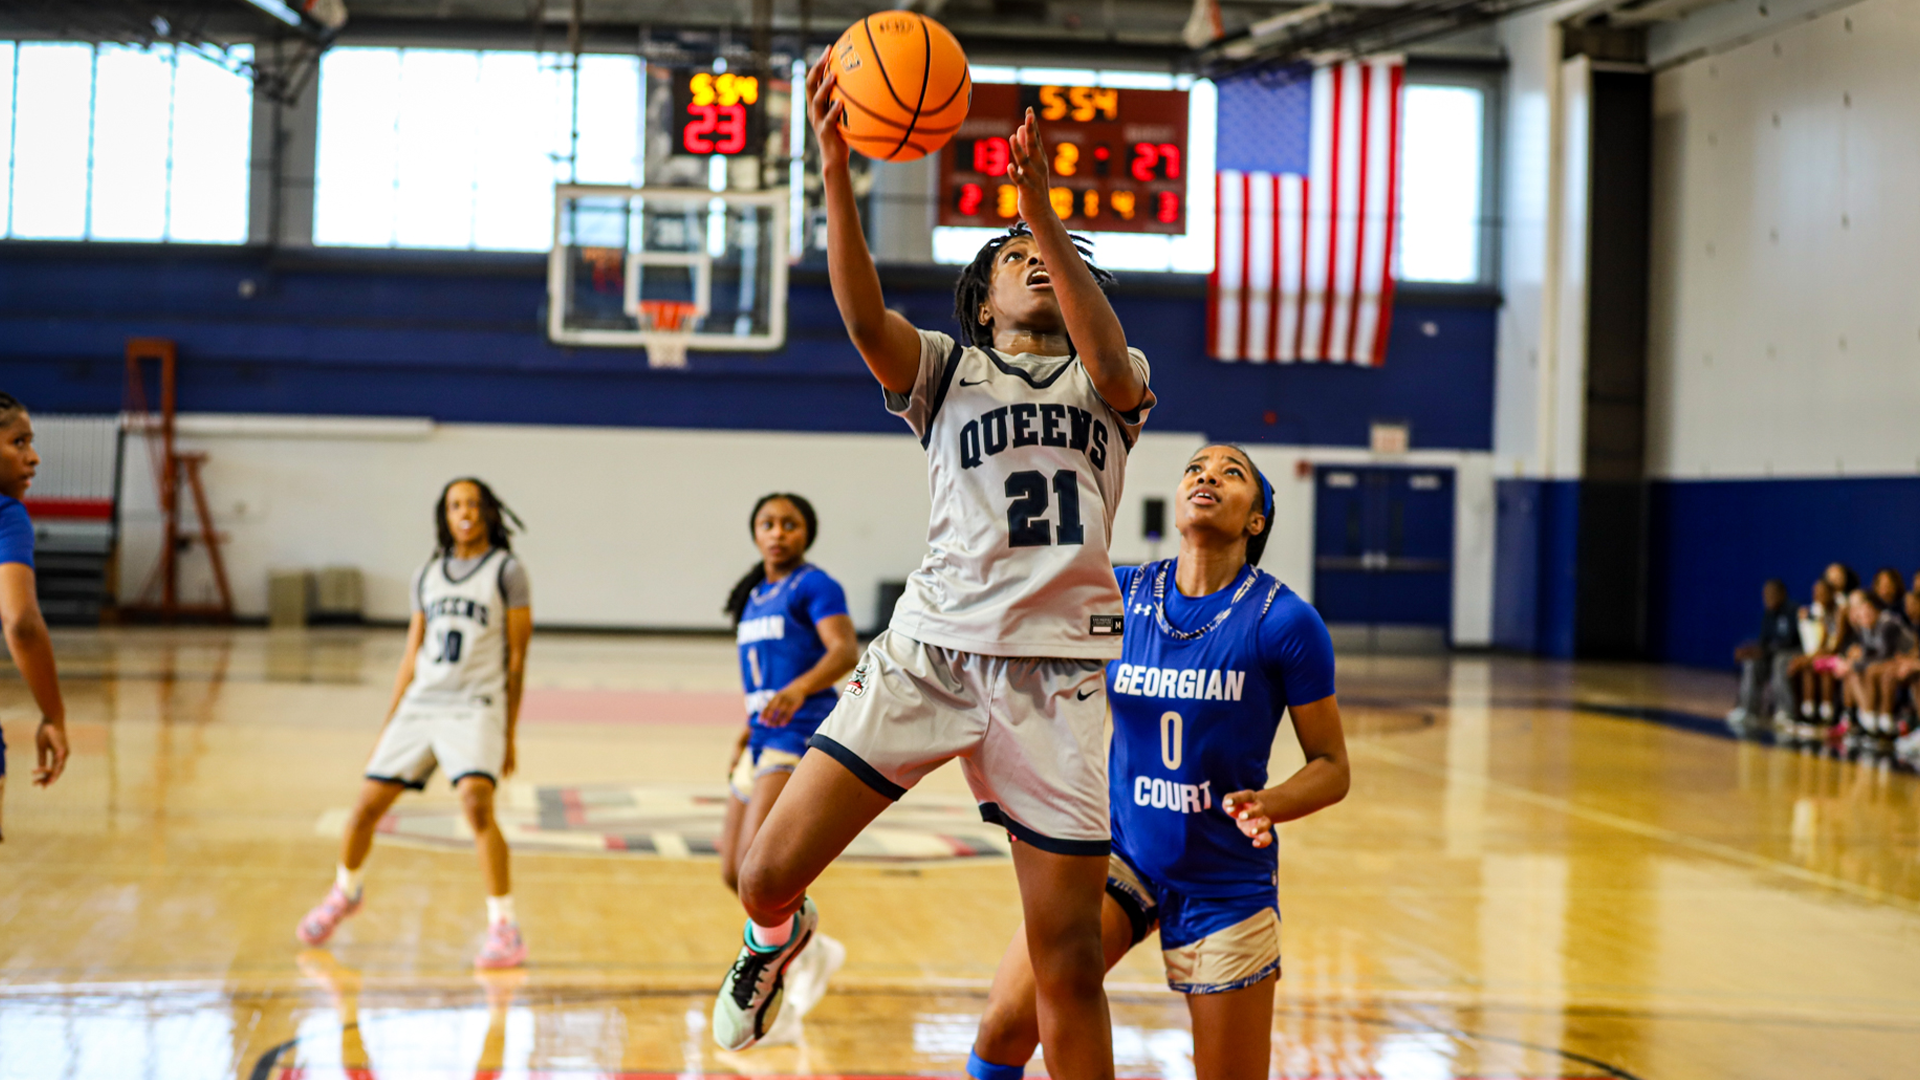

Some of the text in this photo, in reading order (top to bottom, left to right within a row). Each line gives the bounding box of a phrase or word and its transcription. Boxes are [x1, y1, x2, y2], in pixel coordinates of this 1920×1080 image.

[684, 103, 746, 154] 23
[1131, 142, 1180, 182] 27
[960, 403, 1109, 471] QUEENS
[1004, 469, 1084, 548] 21
[1113, 663, 1246, 701] GEORGIAN
[1160, 711, 1183, 770] 0
[1134, 776, 1212, 813] COURT
